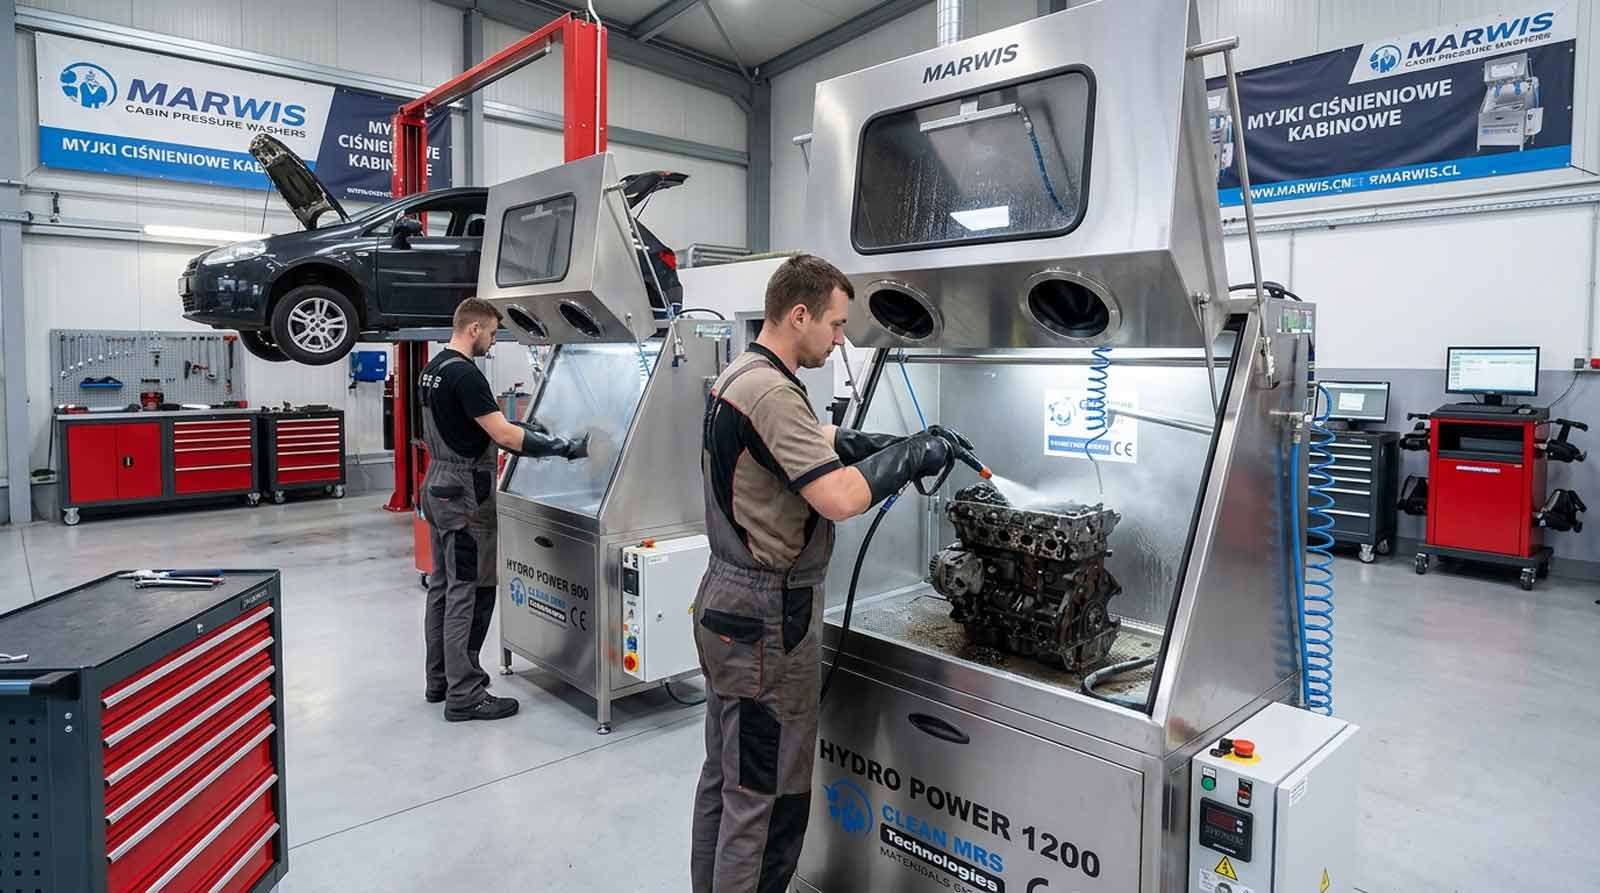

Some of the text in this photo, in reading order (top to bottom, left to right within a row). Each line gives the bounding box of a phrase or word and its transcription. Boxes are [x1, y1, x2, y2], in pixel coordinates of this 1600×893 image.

[1406, 12, 1554, 60] MARWIS
[922, 43, 1019, 84] MARWIS
[125, 104, 306, 138] CABIN PRESSURE WASHERS
[126, 79, 306, 126] MARWIS
[1247, 79, 1452, 130] MYJKI CIŚNIENIOWE
[1287, 109, 1402, 142] KABINOWE
[62, 137, 116, 157] MYJKI
[121, 144, 230, 170] CIŚNIENIOWE
[349, 153, 432, 176] KABINE
[506, 559, 534, 579] HYDRO
[820, 738, 1101, 879] HYDRO POWER 1200
[881, 804, 1004, 873] CLEAN MRS
[886, 828, 999, 893] Technologies
